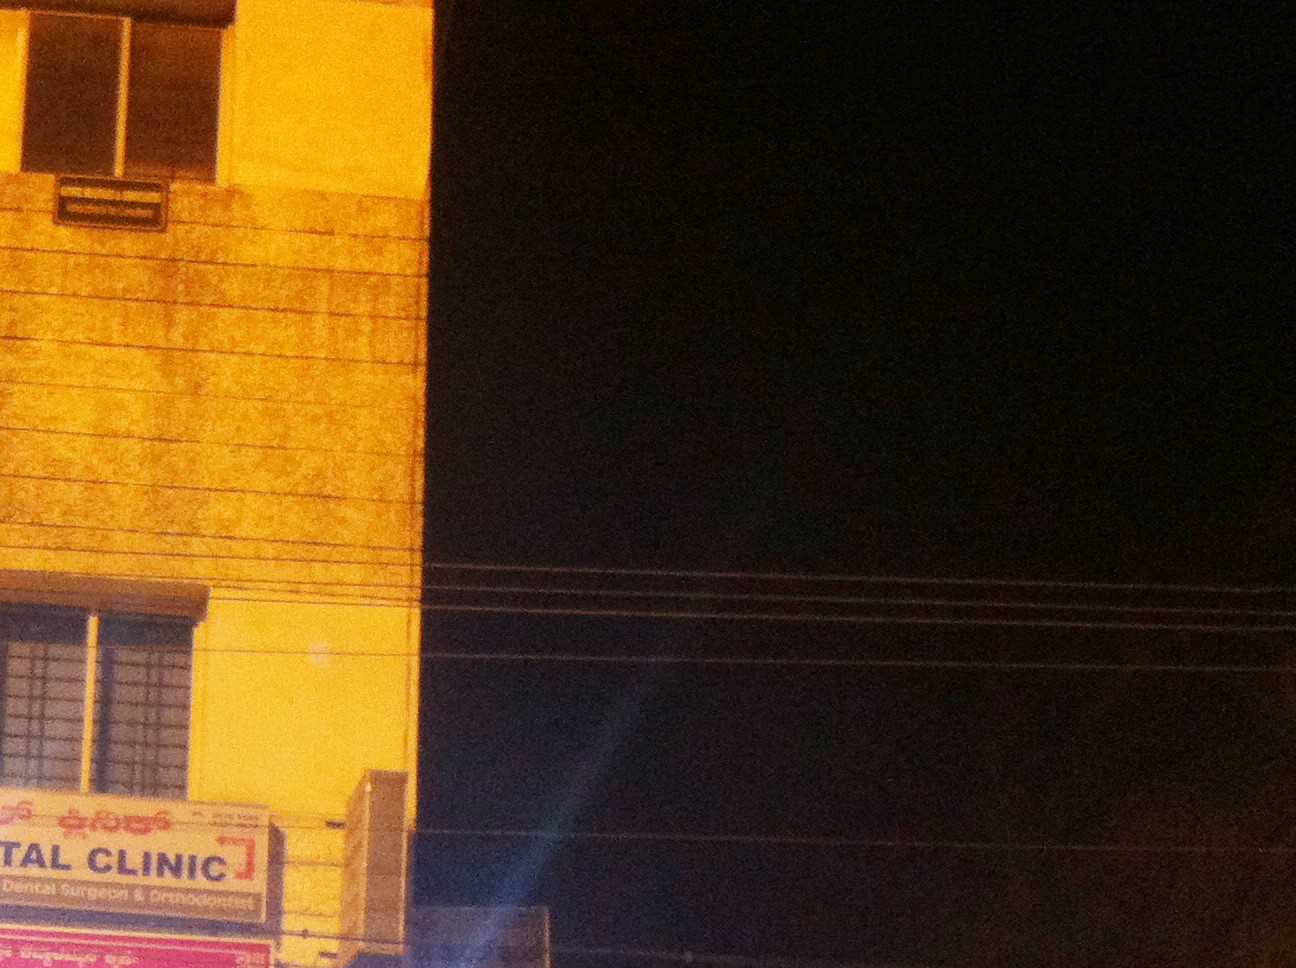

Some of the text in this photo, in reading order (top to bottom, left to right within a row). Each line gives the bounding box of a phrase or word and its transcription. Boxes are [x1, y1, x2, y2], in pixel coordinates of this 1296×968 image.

[87, 847, 227, 881] CLINIC
[3, 879, 54, 896] Dental
[60, 883, 129, 902] Surgeon
